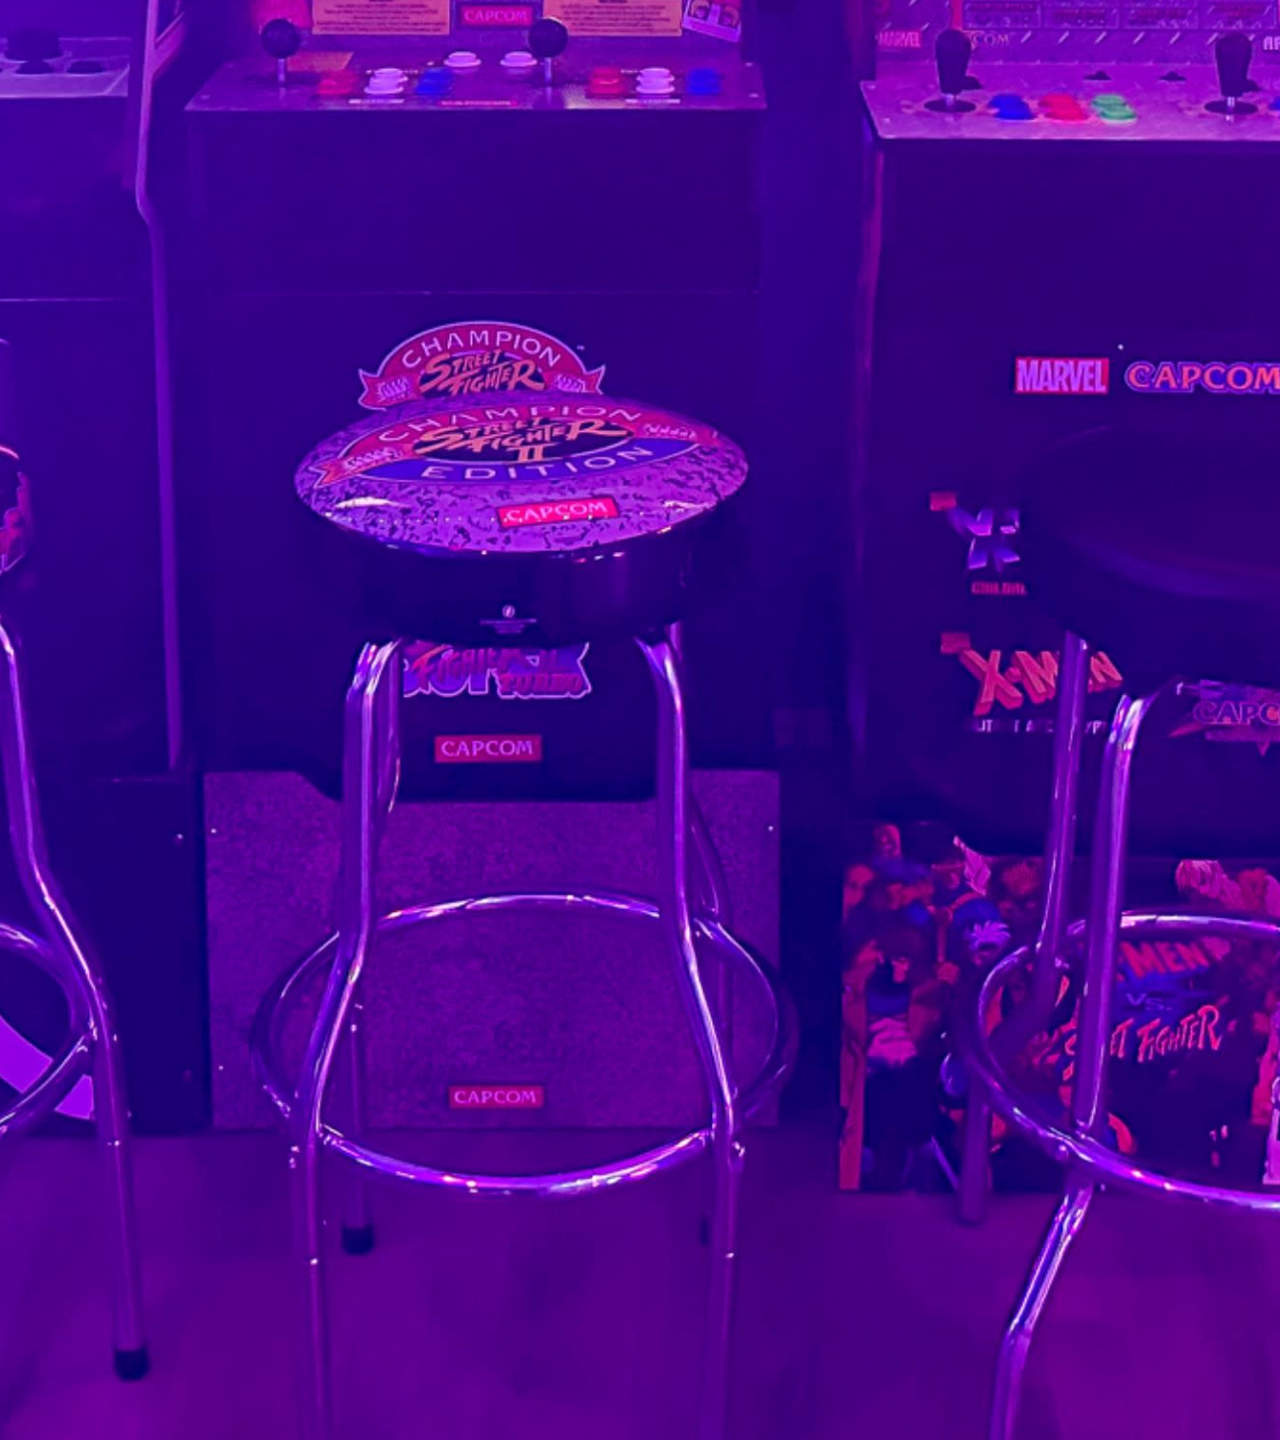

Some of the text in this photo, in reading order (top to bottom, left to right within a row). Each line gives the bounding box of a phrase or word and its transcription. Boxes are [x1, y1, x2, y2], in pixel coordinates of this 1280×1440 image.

[464, 9, 529, 23] CAPCOM
[401, 330, 560, 368] CHAMPION
[420, 349, 503, 393] STREET
[441, 359, 546, 397] FIGHTER
[1016, 358, 1107, 393] MARVEL
[378, 406, 641, 442] CHAMPION
[414, 417, 541, 456] STREET
[450, 418, 629, 455] FIGHTER
[421, 445, 656, 481] EDITION
[506, 500, 608, 523] CAPCOM
[958, 648, 1124, 717] X-MN
[441, 740, 534, 757] CAPCOM
[453, 1090, 537, 1104] CAPCOM
